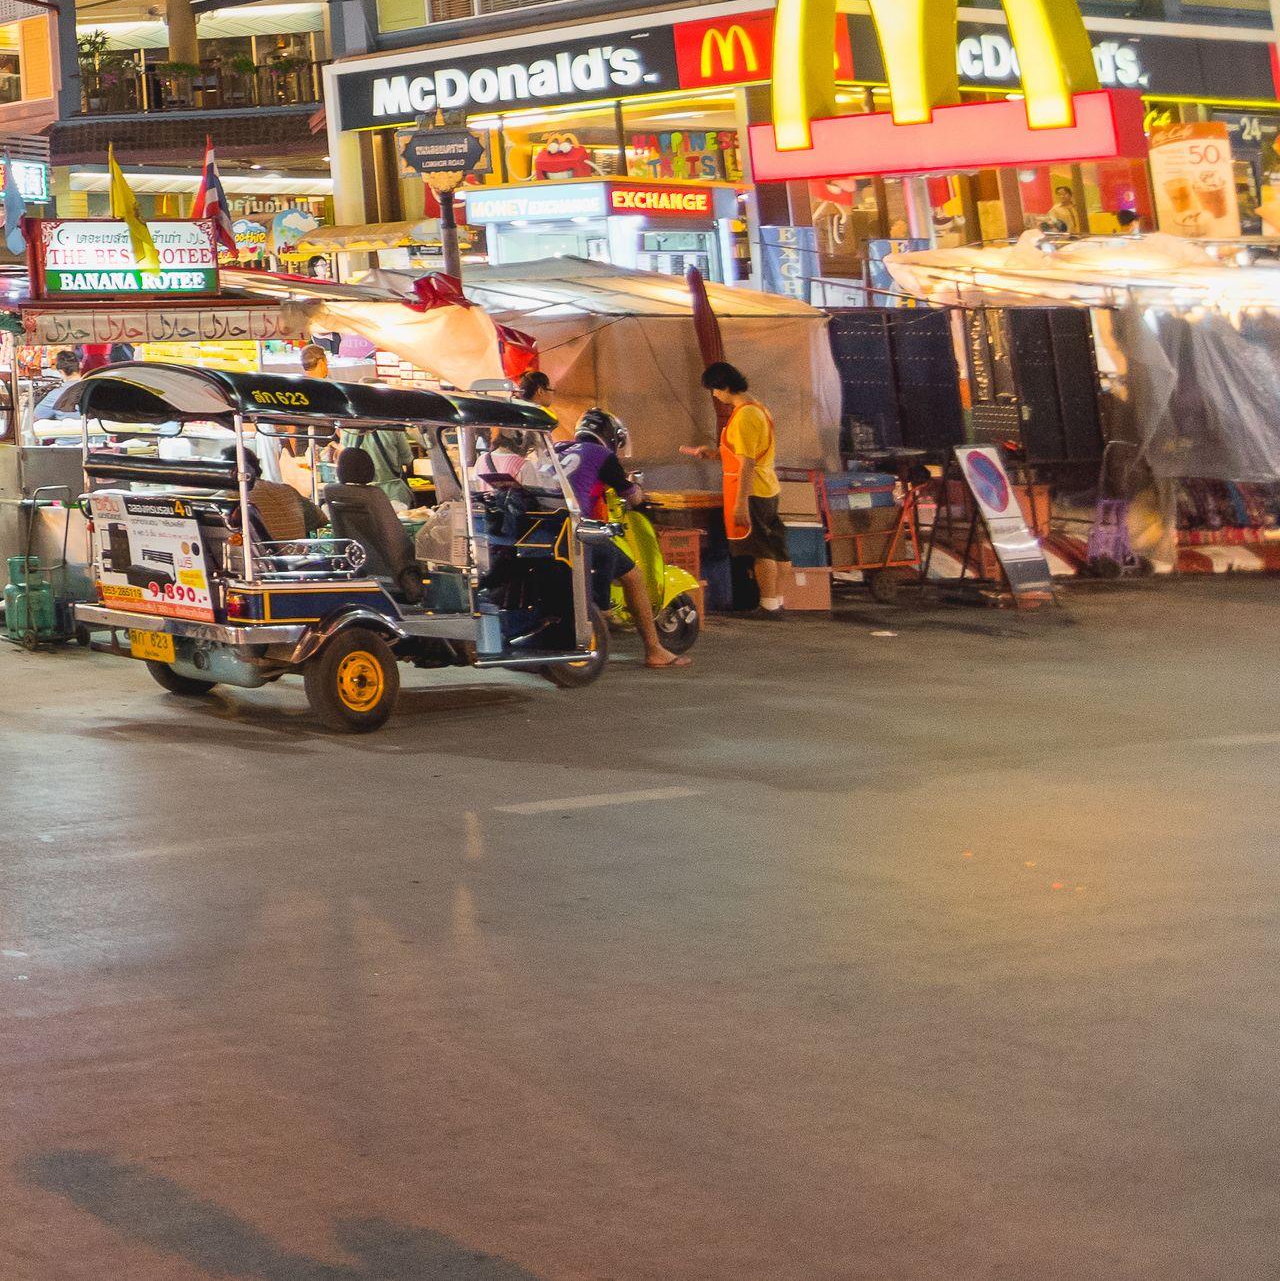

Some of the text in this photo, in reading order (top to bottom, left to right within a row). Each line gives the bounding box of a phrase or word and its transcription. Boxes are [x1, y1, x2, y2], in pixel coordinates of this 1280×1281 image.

[372, 47, 641, 116] McDonald's
[1241, 118, 1261, 140] 24
[1188, 145, 1220, 164] 50
[471, 198, 528, 217] MONEY
[612, 191, 708, 211] EXCHANGE
[49, 249, 87, 265] THE
[95, 249, 130, 264] BES
[60, 272, 205, 291] BANANA ROTEE
[276, 391, 309, 406] 623
[175, 501, 185, 516] 4
